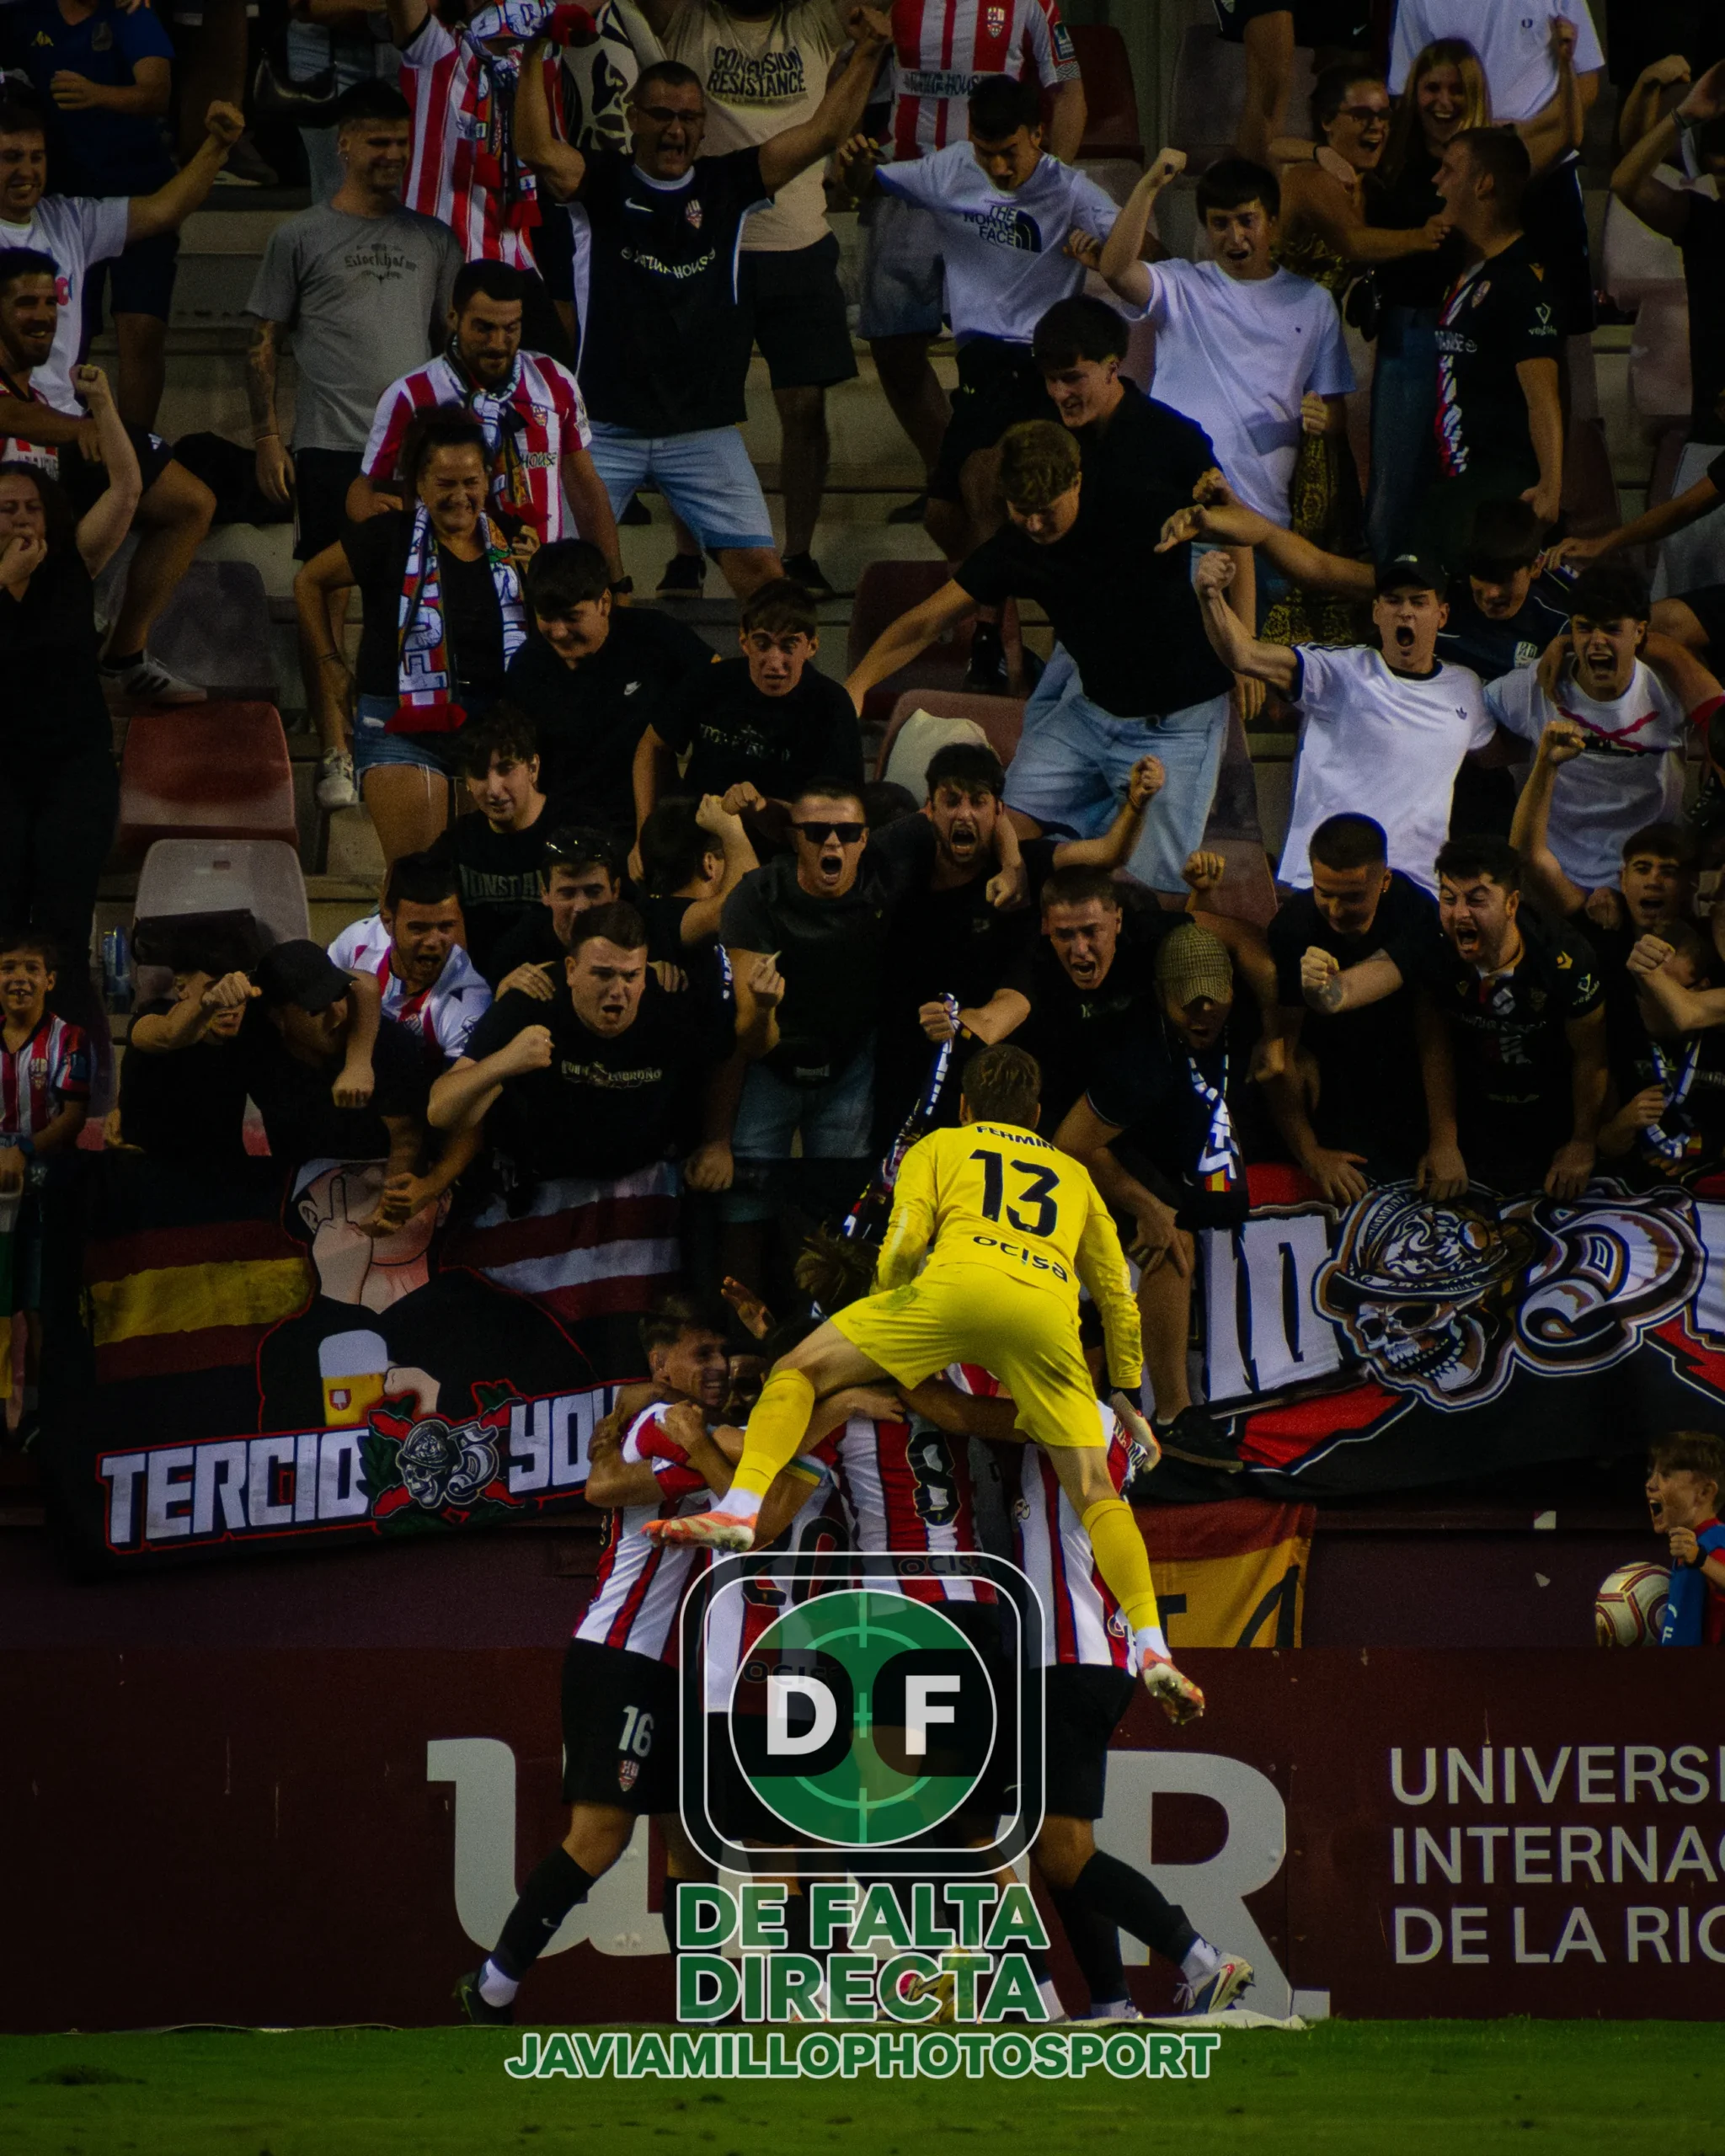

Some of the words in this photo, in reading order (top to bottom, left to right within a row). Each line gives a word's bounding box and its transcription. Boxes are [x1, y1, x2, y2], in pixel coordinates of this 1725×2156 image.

[708, 69, 806, 97] RESISTANCE
[964, 211, 1016, 232] NORTH
[979, 226, 1015, 247] FACE
[990, 205, 1017, 222] THE
[969, 1149, 1060, 1238] 13
[100, 1428, 371, 1545] TERCIO
[618, 1705, 654, 1758] 16
[1391, 1826, 1725, 1884] INTERNA
[1394, 1908, 1490, 1964] DE
[1513, 1907, 1607, 1964] LA
